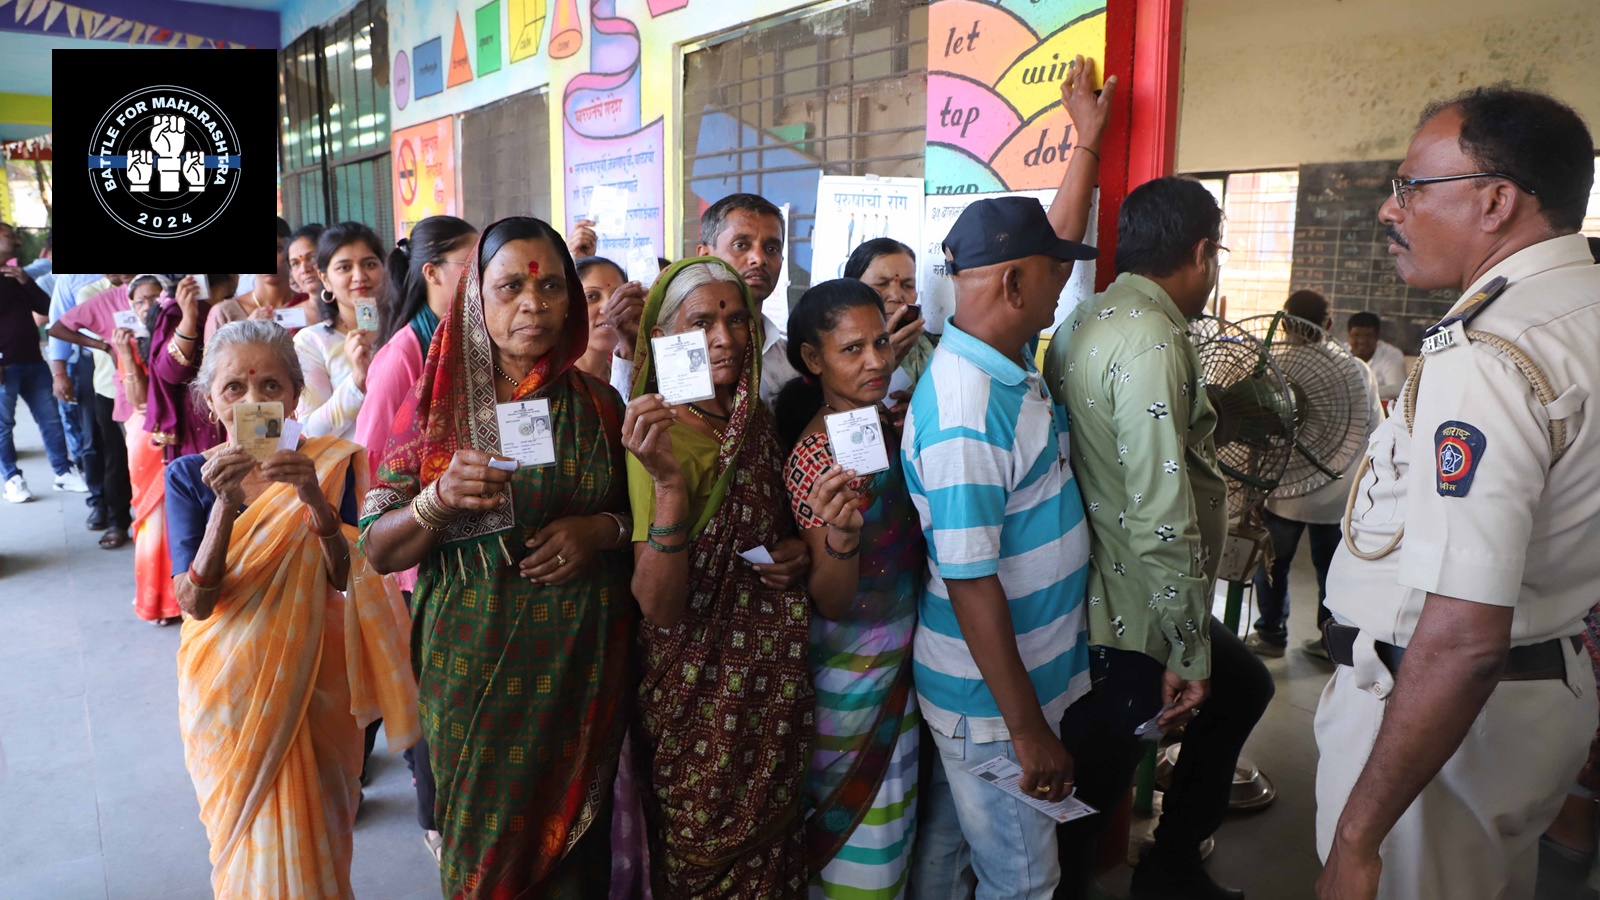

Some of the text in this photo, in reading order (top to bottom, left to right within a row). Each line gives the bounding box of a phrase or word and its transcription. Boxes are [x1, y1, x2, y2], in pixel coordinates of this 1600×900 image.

[944, 20, 981, 57] let
[940, 96, 980, 138] tap
[1023, 124, 1075, 167] dot
[834, 188, 908, 212] पुरुषांची रांग
